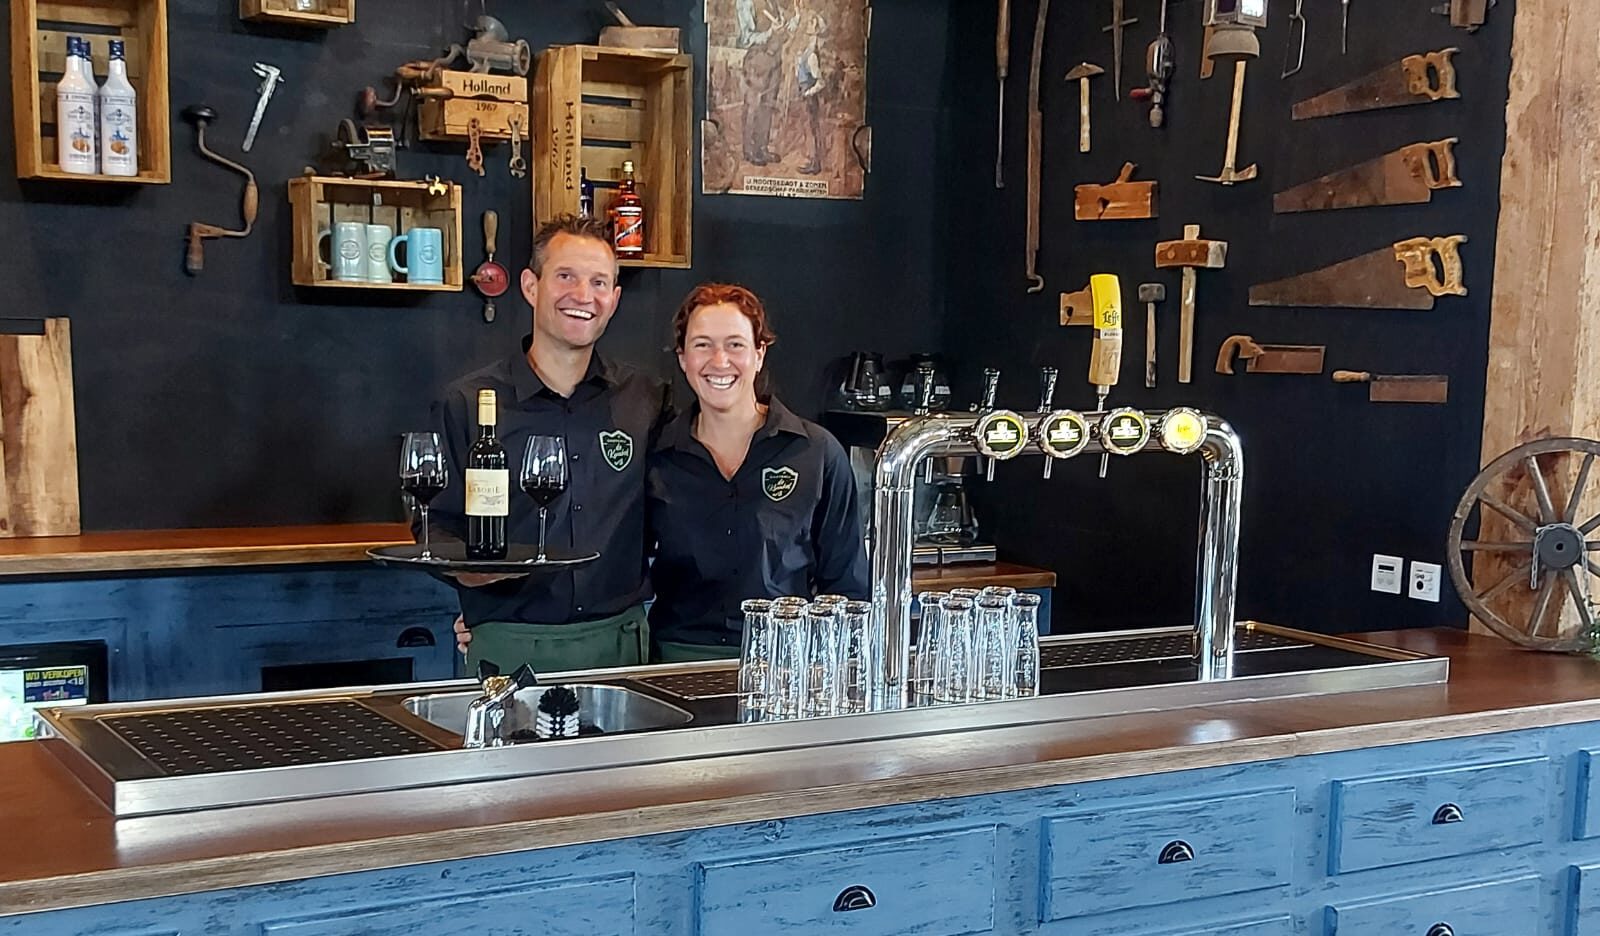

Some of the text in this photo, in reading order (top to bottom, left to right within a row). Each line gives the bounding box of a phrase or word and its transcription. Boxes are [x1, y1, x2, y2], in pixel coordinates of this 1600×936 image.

[463, 79, 511, 95] Holland
[475, 103, 498, 112] 1967
[565, 101, 574, 190] Holland
